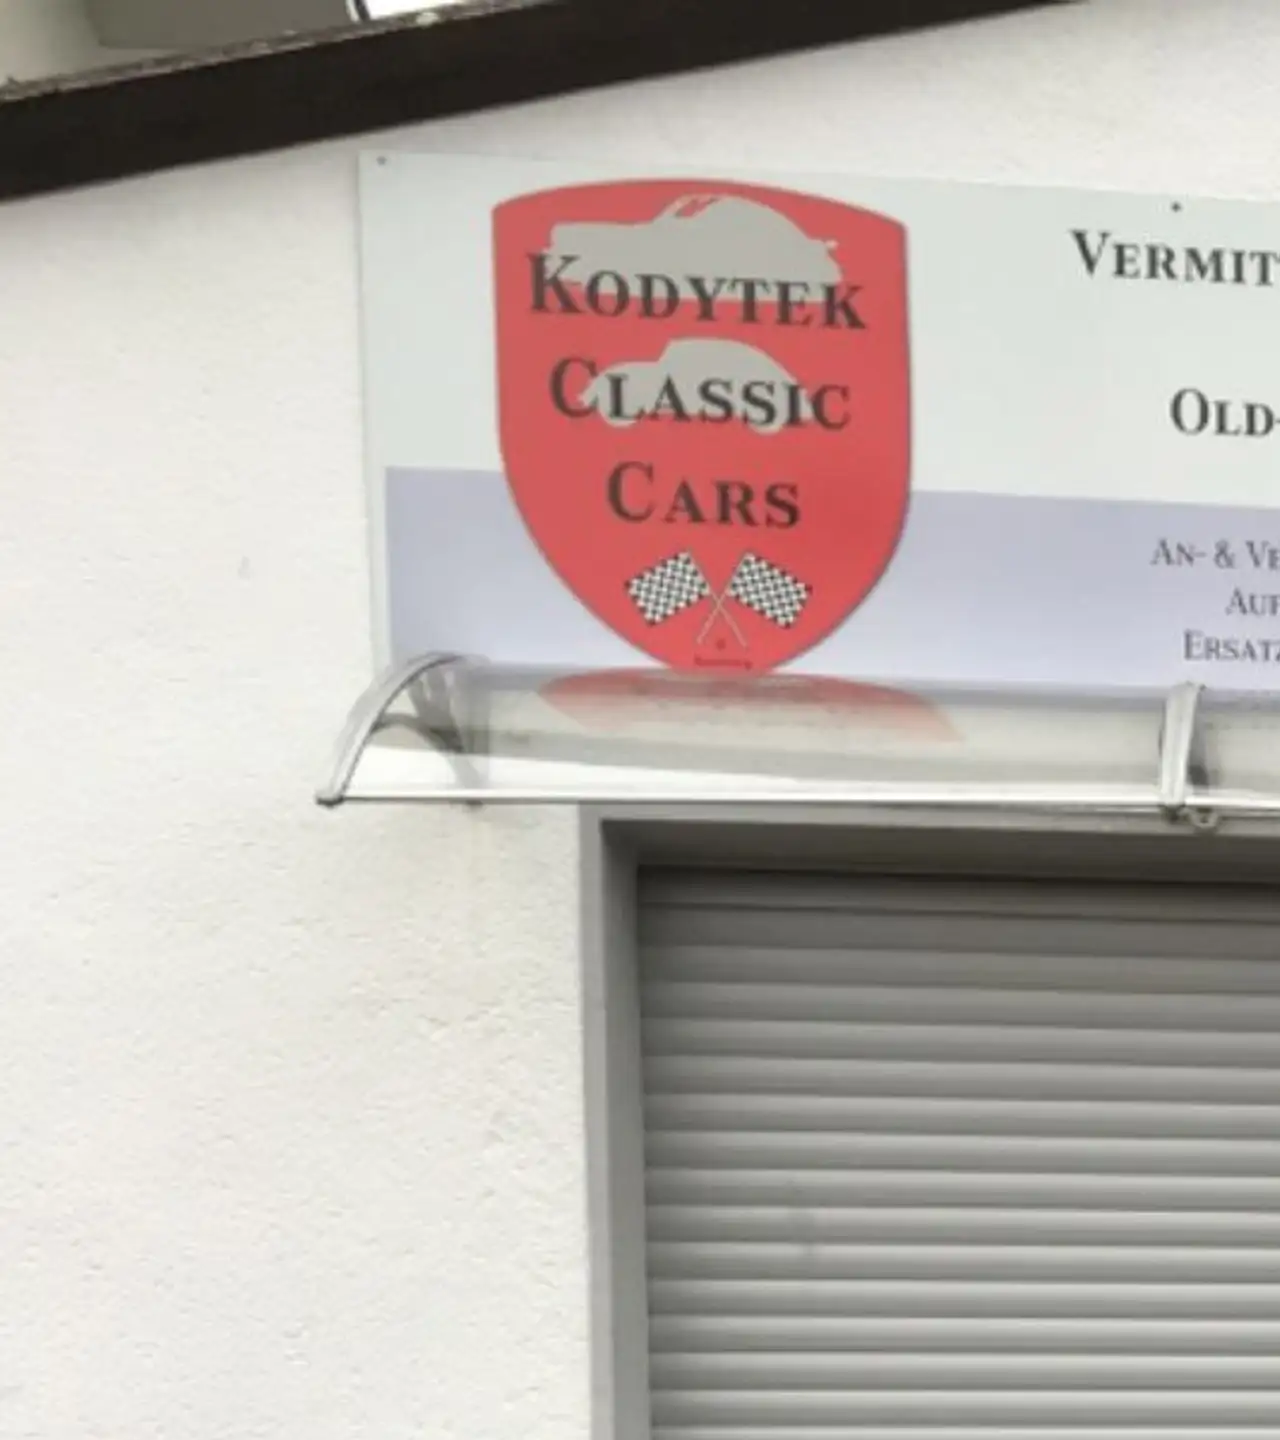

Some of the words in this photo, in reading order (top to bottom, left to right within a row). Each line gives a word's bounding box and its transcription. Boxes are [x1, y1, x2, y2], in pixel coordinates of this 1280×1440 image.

[527, 252, 868, 330] KODYTEK
[549, 357, 853, 432] CLASSIC
[606, 461, 802, 528] CARS
[1150, 538, 1207, 570] AN-
[1214, 541, 1235, 571] &
